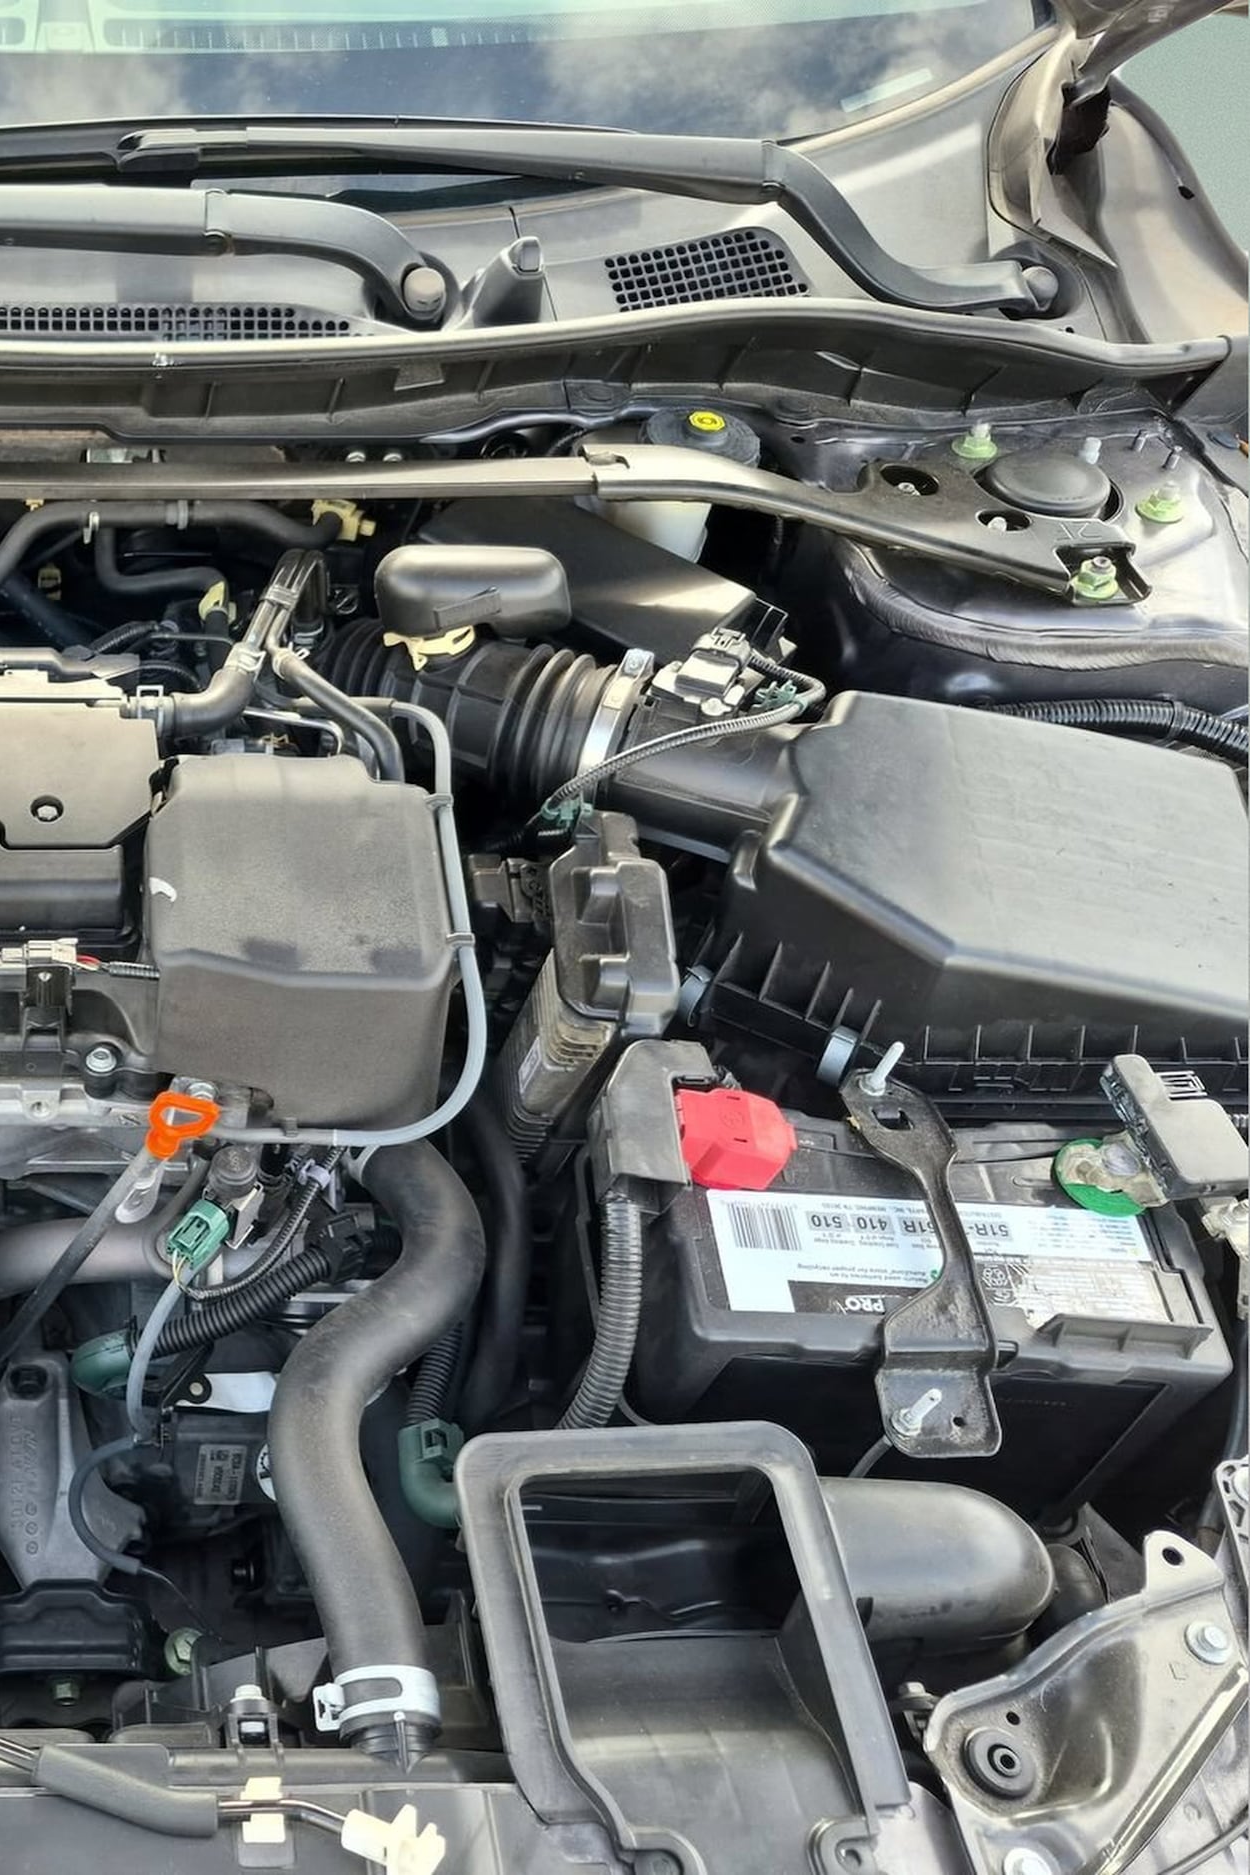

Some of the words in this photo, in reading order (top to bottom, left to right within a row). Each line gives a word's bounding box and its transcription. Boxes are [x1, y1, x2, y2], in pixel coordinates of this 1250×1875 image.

[811, 1214, 842, 1228] 510
[857, 1216, 887, 1231] 410
[965, 1223, 1009, 1237] 51R-
